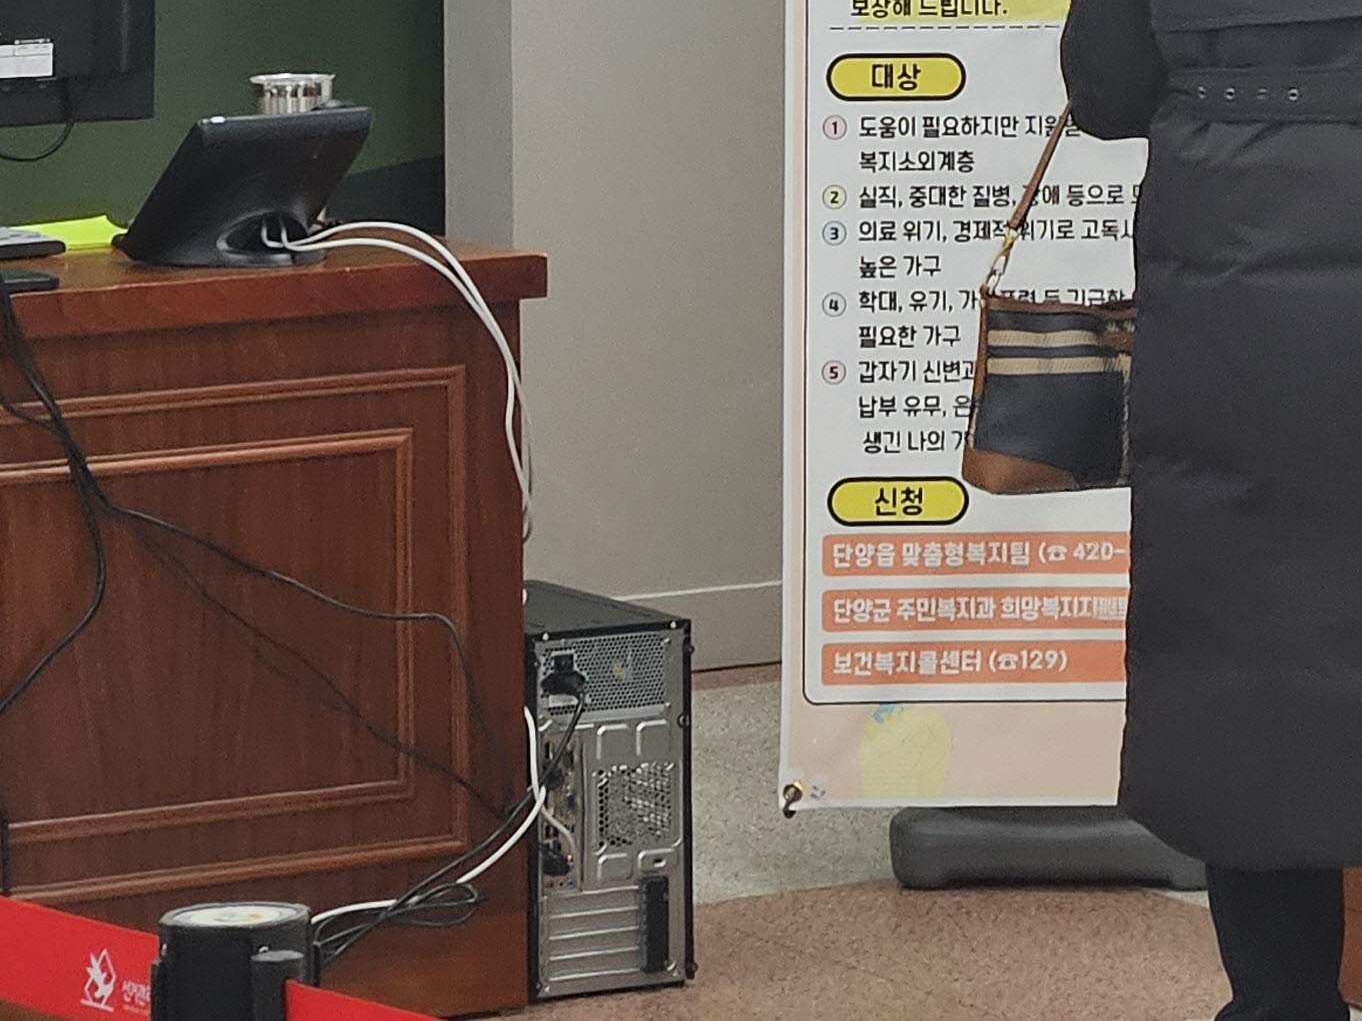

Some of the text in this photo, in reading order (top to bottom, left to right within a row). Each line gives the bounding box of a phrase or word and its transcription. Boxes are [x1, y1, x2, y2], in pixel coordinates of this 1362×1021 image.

[871, 63, 922, 92] 대상
[859, 116, 916, 139] 도움이
[922, 115, 1020, 139] 필요하지만
[859, 150, 975, 174] 복지소외계층
[859, 185, 903, 209] 실직,
[908, 185, 967, 209] 중대한
[972, 185, 1017, 208] 질병,
[1066, 184, 1125, 207] 등으로
[858, 220, 897, 242] 의료
[902, 220, 947, 243] 위기,
[859, 255, 942, 279] 높은 가구
[858, 290, 903, 314] 학대,
[908, 290, 953, 313] 유기,
[858, 325, 961, 349] 필요한 가구
[858, 360, 916, 384] 갑자기
[858, 395, 897, 419] 납부
[903, 395, 947, 418] 유무,
[863, 430, 901, 454] 생긴
[907, 430, 945, 452] 나의
[874, 486, 923, 517] 신청
[832, 541, 896, 569] 단양읍
[901, 541, 1031, 568] 맞춤형복지팀
[833, 599, 893, 626] 단양군
[897, 598, 996, 625] 주민복지과
[832, 651, 983, 677] 보건복지콜센터
